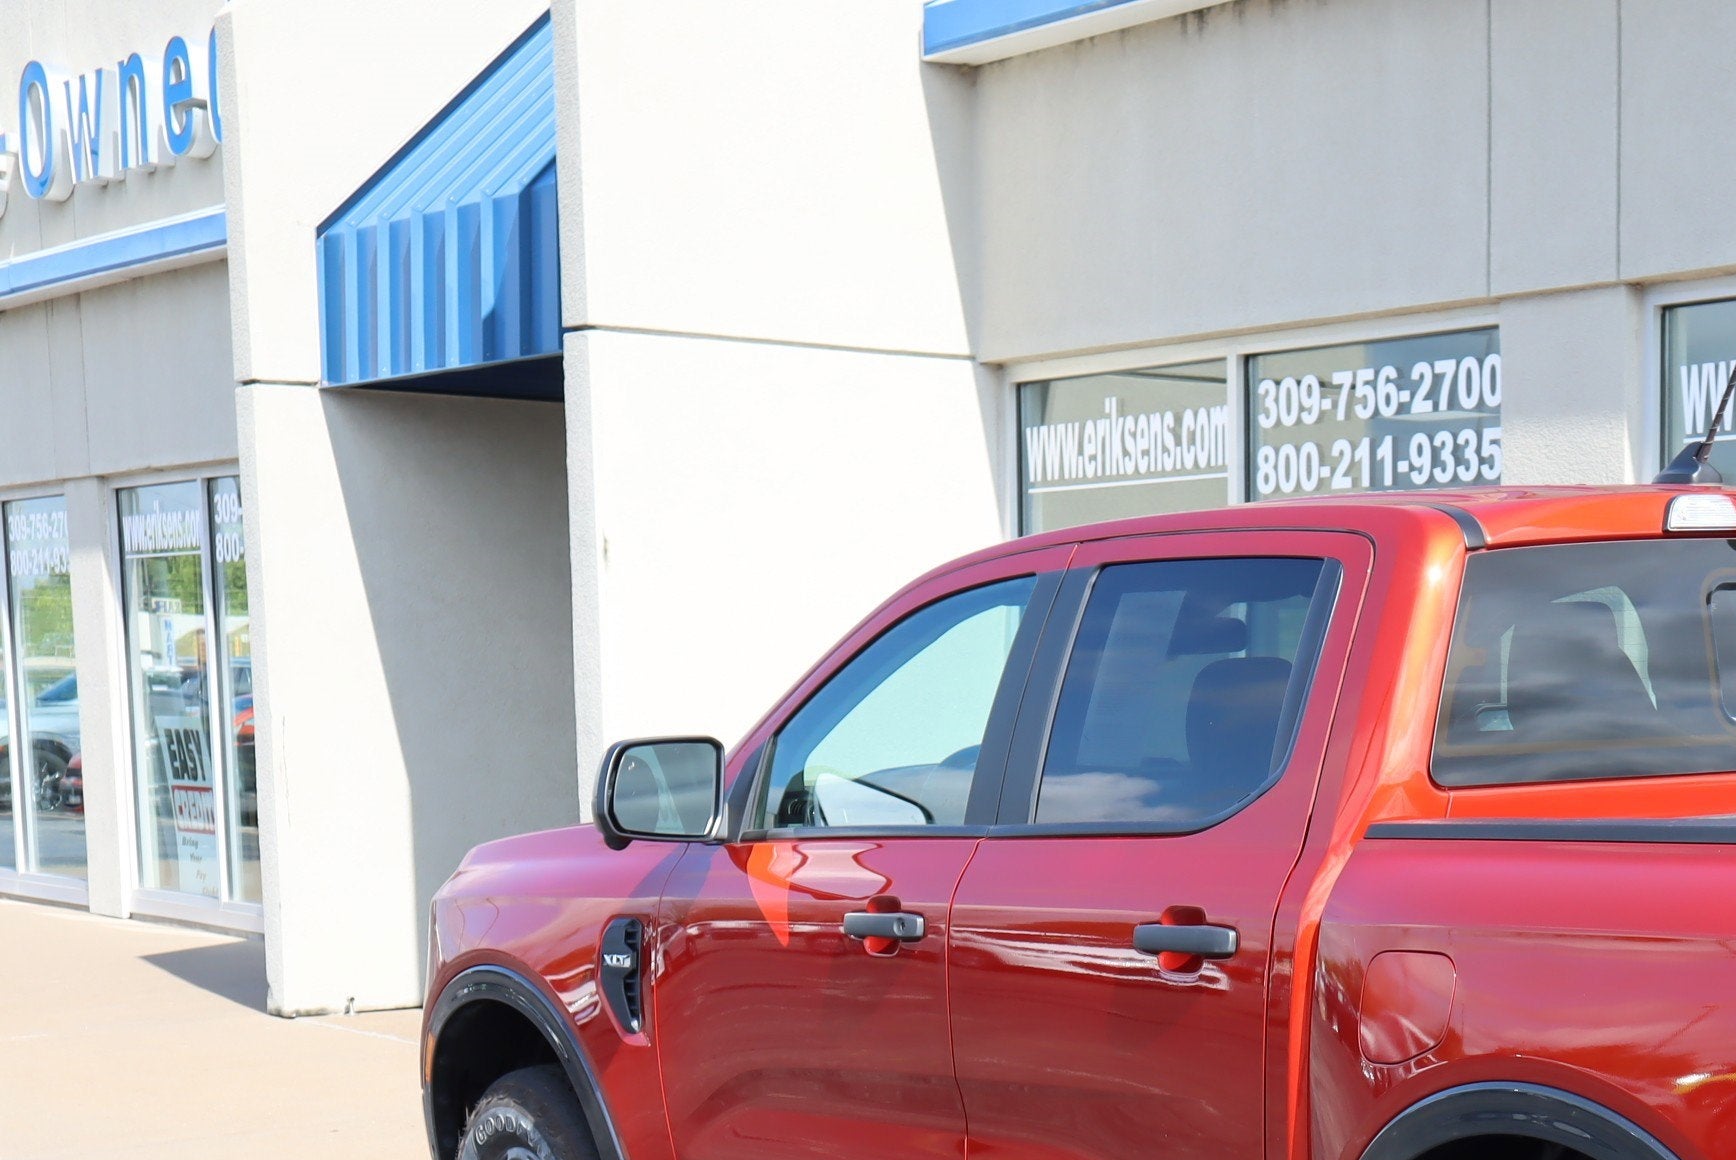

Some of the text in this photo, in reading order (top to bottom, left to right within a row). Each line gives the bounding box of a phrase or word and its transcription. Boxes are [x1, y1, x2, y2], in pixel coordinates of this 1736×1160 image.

[1257, 354, 1502, 429] 309-756-2700
[1026, 396, 1228, 483] www.eriksens.com
[1255, 427, 1502, 495] 800-211-9335
[165, 728, 206, 782] EASY
[603, 954, 632, 968] XLT
